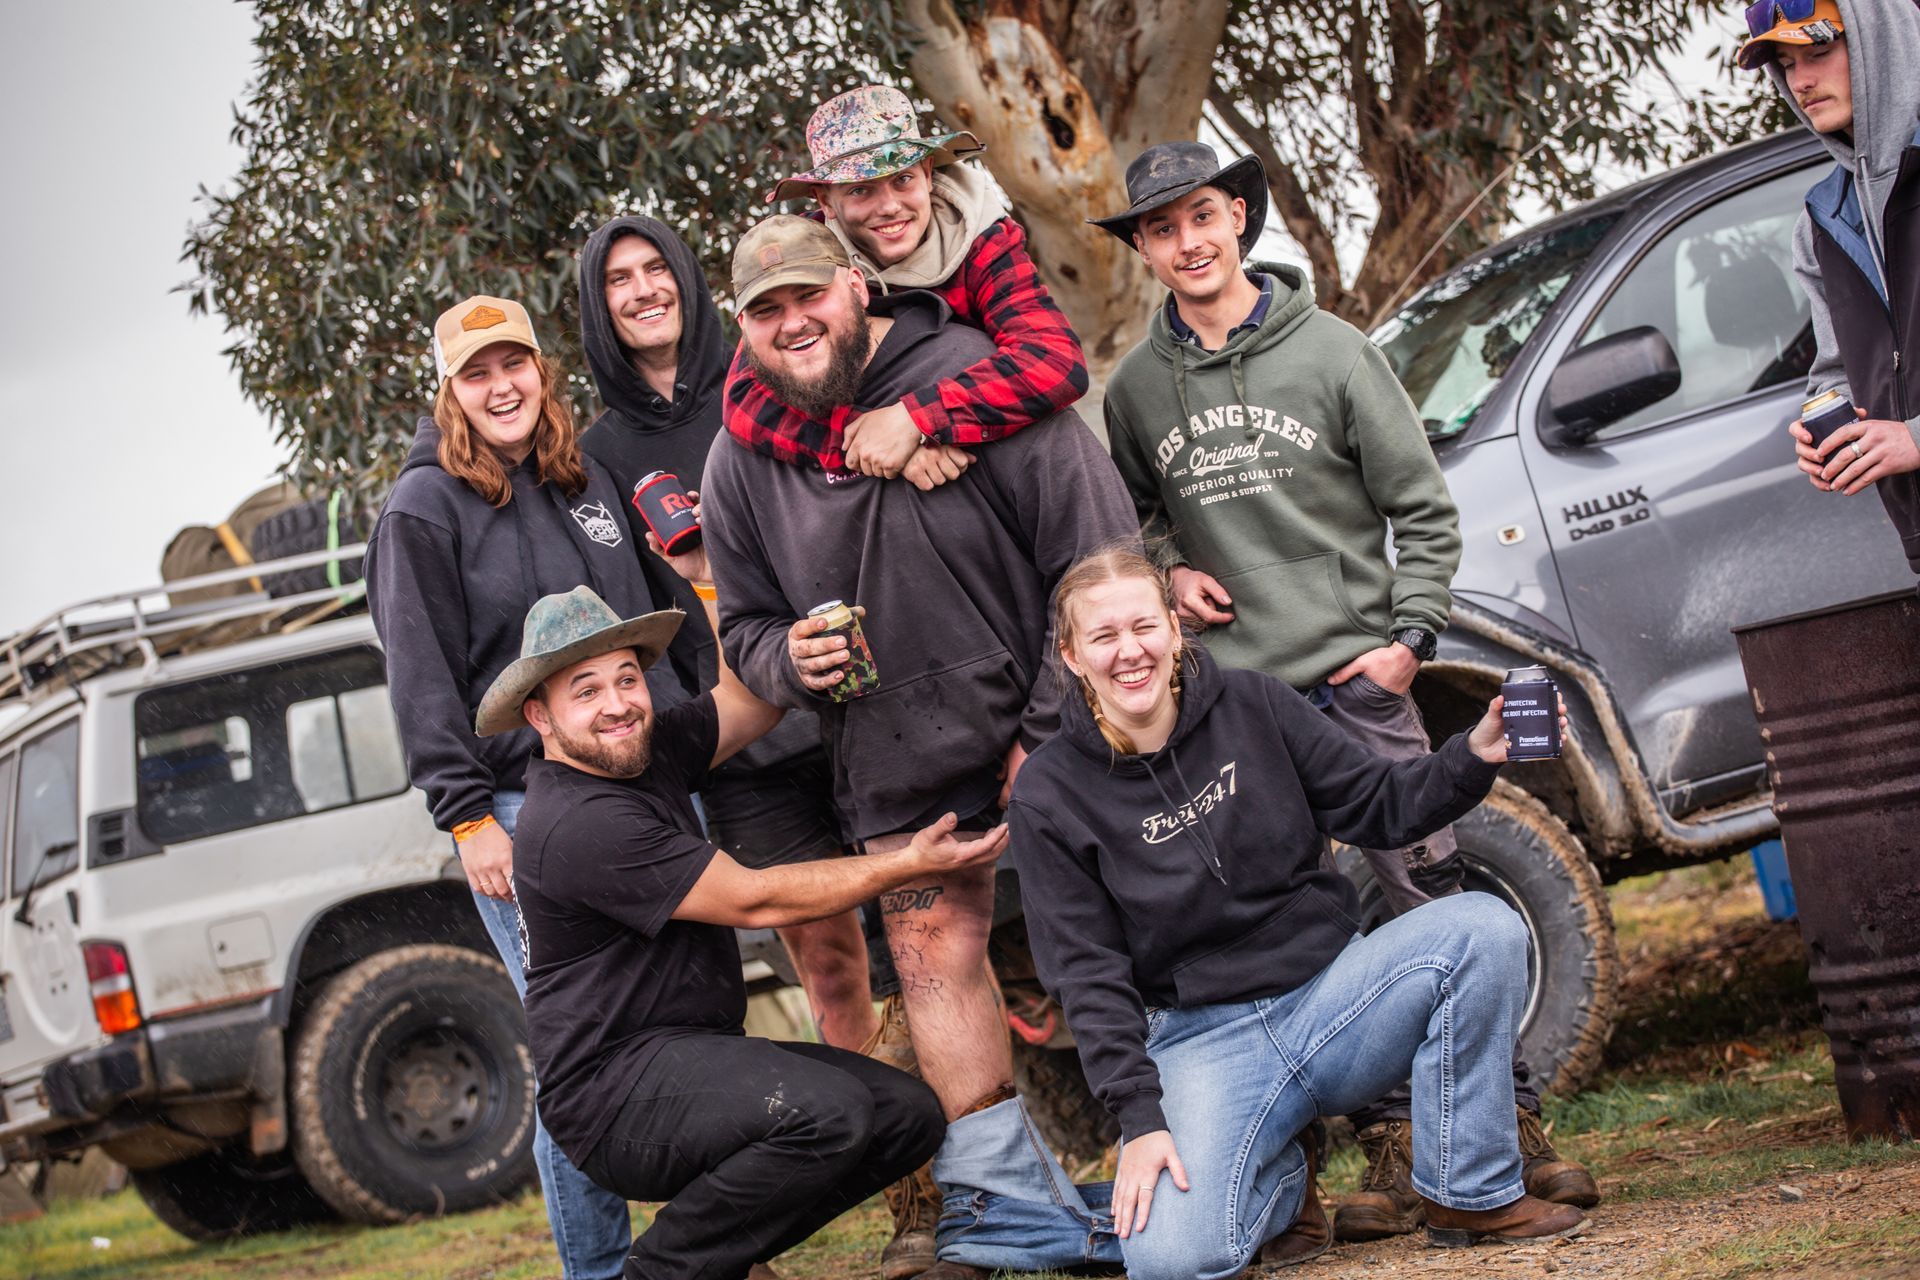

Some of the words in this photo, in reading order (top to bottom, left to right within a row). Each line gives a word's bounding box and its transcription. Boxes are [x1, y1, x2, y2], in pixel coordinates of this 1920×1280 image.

[1155, 426, 1185, 479] LOS
[1189, 405, 1318, 451] ANGELES
[1172, 468, 1188, 478] SINCE
[1189, 433, 1265, 477] Original
[1179, 476, 1236, 498] SUPERIOR
[1238, 467, 1294, 482] QUALITY
[1200, 493, 1230, 506] GOODS
[1239, 484, 1273, 496] SUPPLY
[1562, 484, 1649, 524] HILUX
